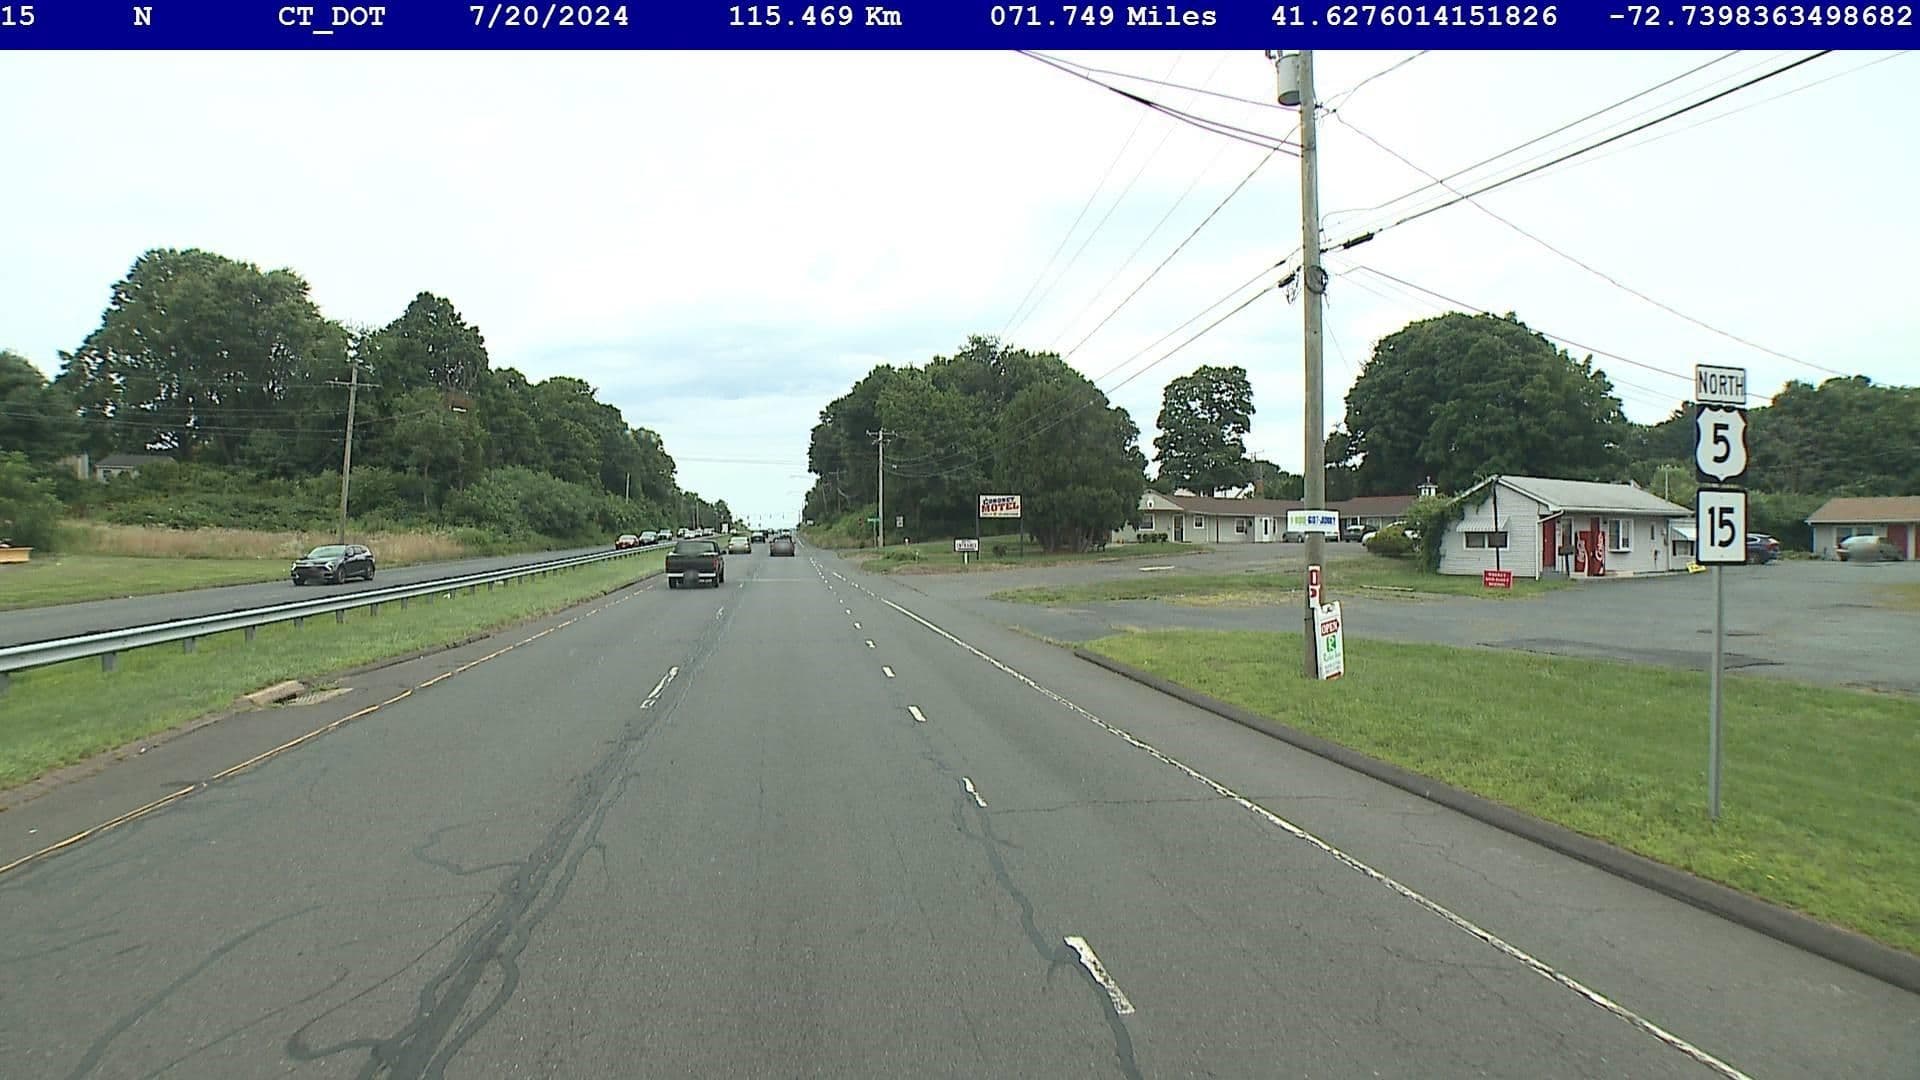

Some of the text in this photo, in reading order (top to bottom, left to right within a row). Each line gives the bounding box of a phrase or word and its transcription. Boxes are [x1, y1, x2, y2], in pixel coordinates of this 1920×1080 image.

[1698, 370, 1744, 396] NORTH
[1712, 423, 1731, 463] 5
[982, 502, 1019, 512] MOTEL
[1708, 506, 1735, 548] 15
[1321, 622, 1338, 635] OPEN
